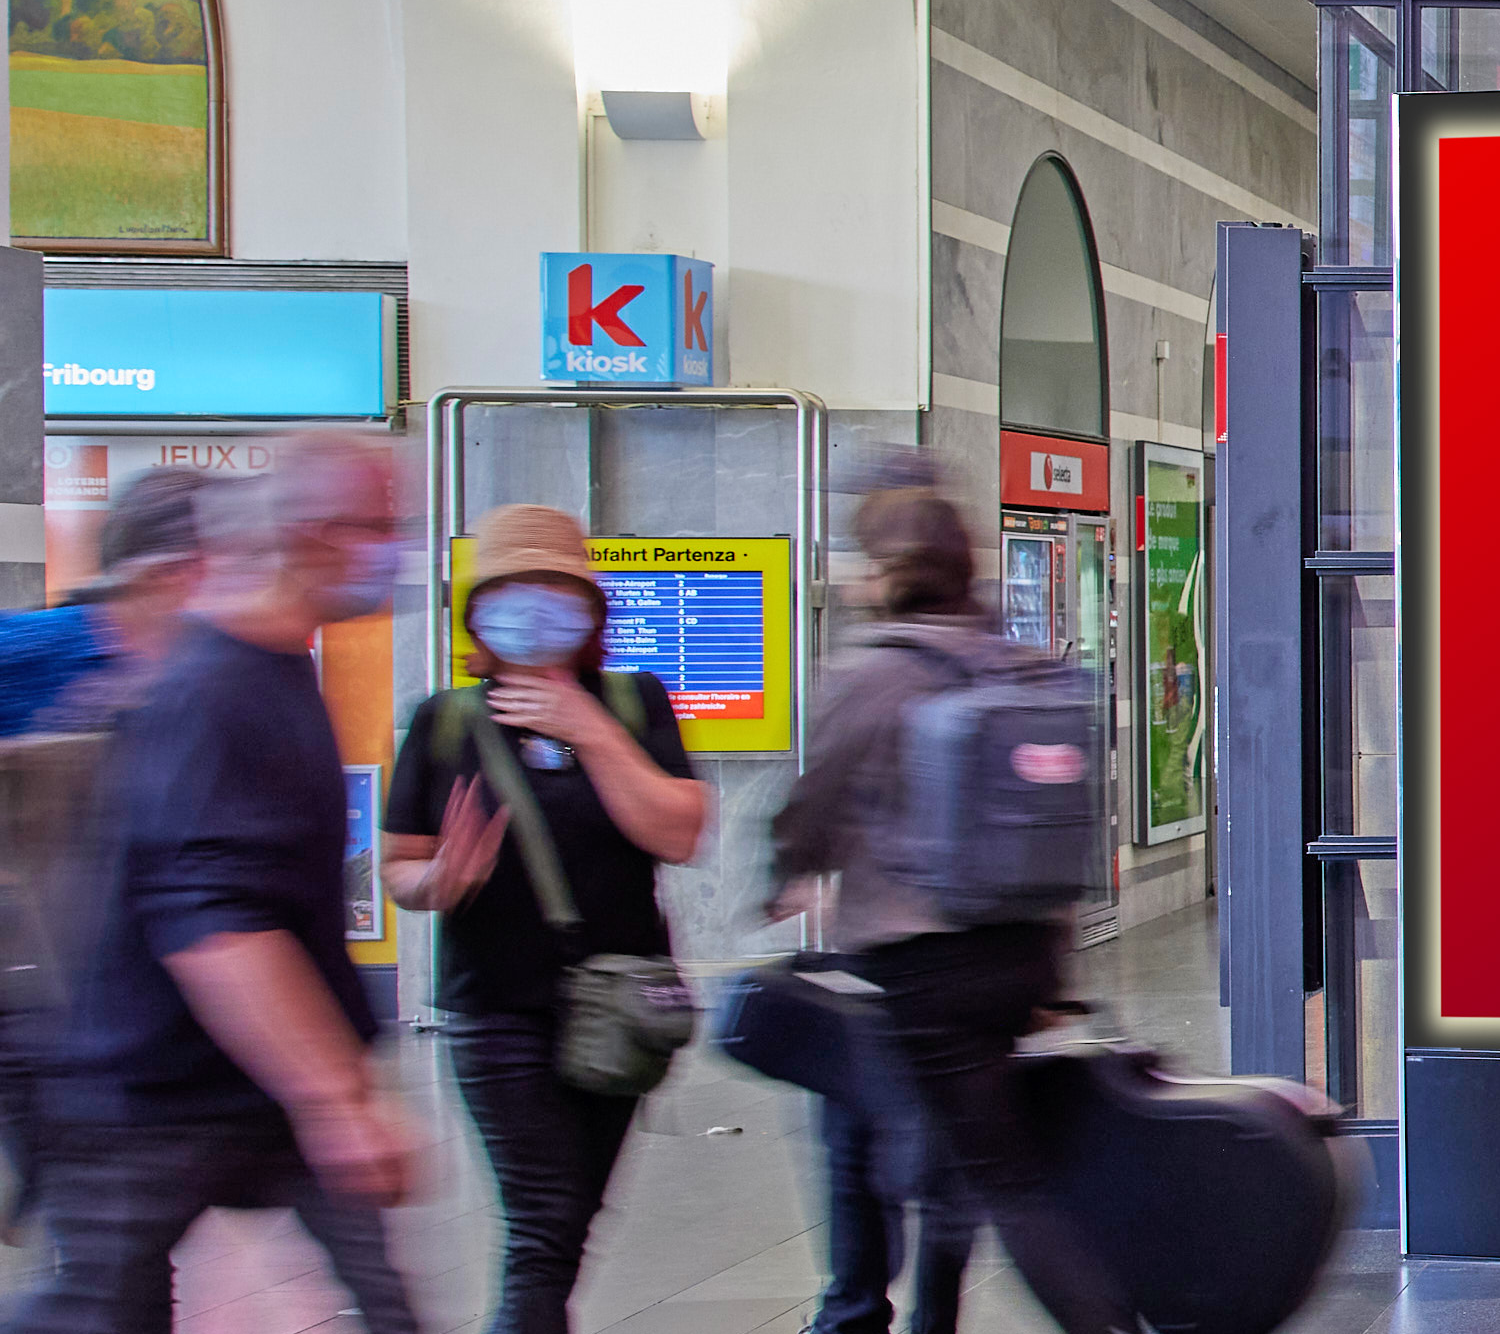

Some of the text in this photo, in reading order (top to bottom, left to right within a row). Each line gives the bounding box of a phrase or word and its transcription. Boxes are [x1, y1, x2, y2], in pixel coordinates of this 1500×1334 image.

[566, 350, 648, 373] kiosk
[43, 363, 156, 391] Fribourg
[57, 477, 107, 486] LOTERIE
[653, 546, 736, 562] Partenza
